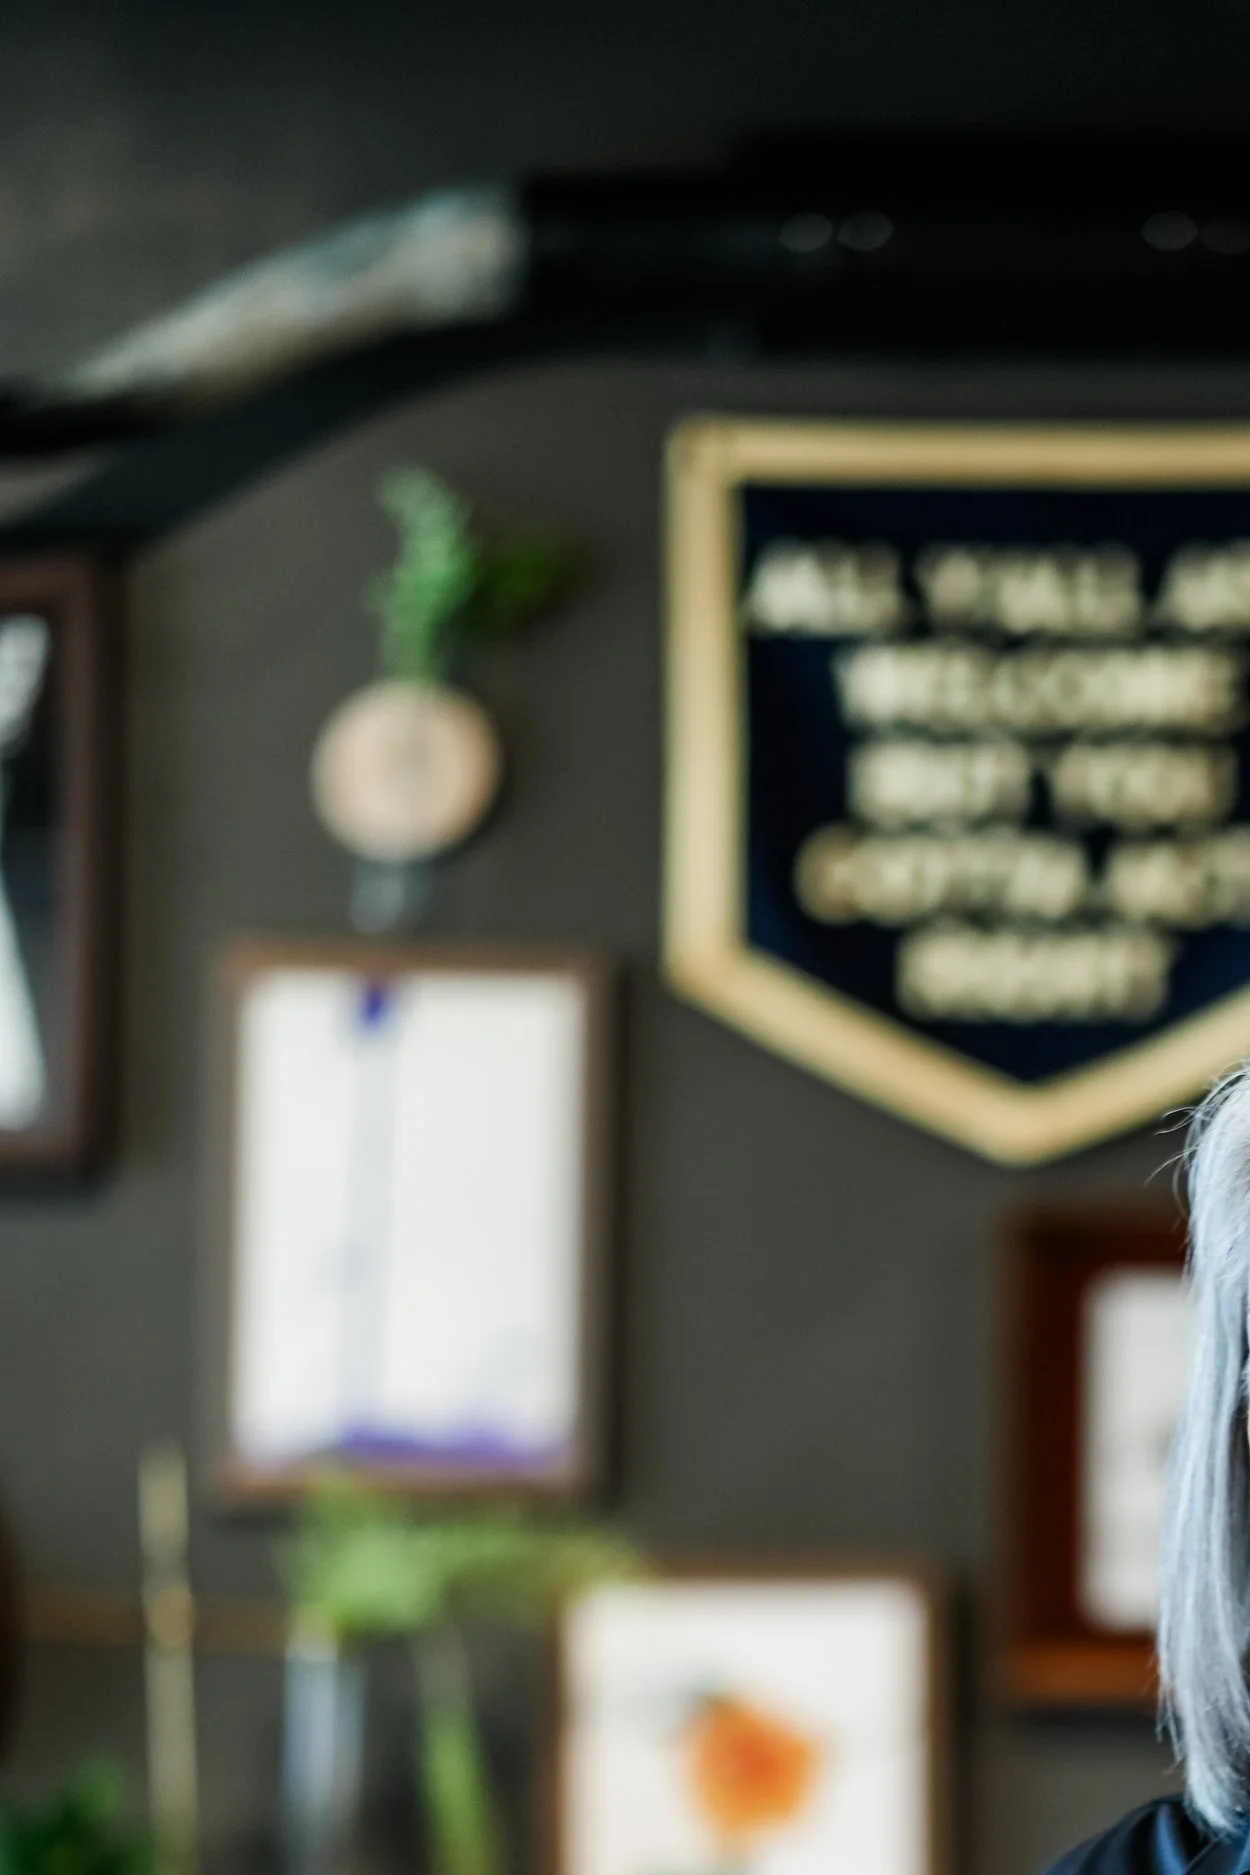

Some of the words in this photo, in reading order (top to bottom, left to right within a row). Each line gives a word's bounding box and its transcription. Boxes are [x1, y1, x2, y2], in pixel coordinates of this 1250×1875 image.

[748, 548, 900, 636] ALL
[833, 641, 1242, 732] WELCOME
[848, 740, 1032, 828] BUT
[1046, 740, 1234, 828] YOU
